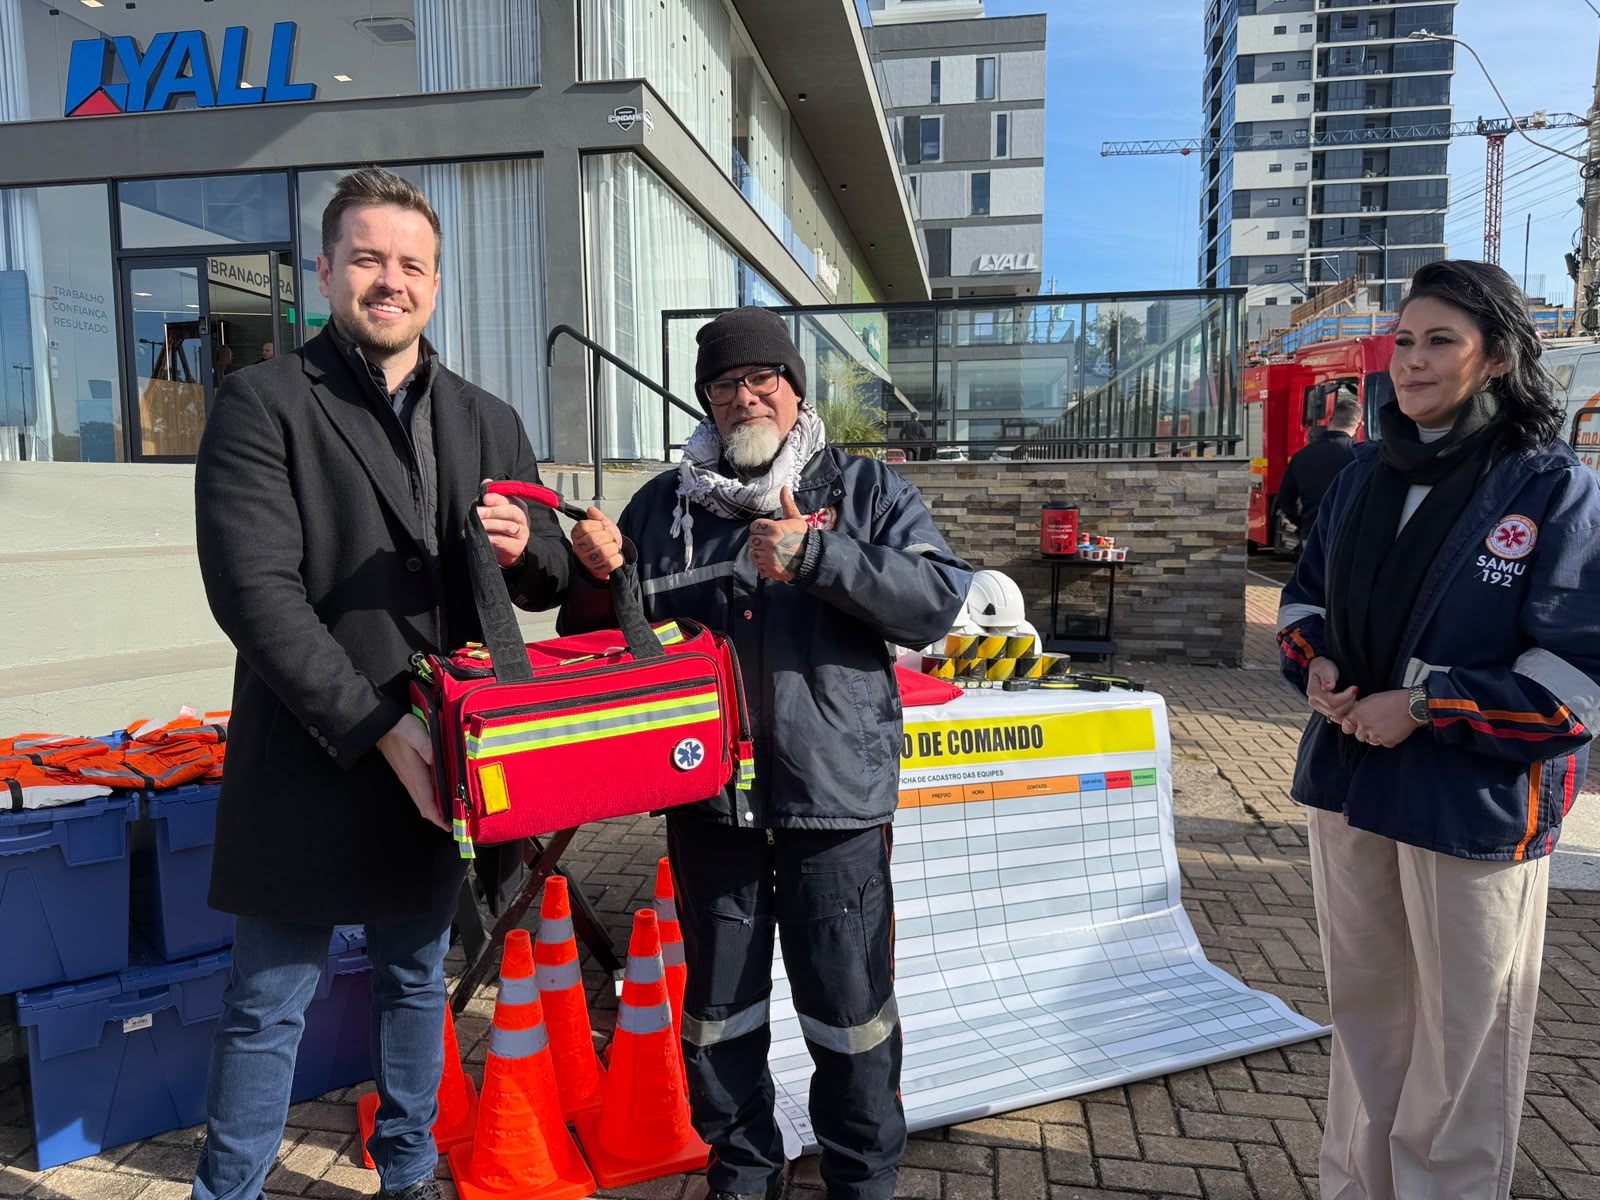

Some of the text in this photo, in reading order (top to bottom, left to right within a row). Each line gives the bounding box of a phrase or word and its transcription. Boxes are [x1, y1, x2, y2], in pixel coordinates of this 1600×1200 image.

[65, 21, 317, 117] LYALL
[978, 252, 1039, 272] LYALL
[52, 285, 105, 304] TRABALHO
[52, 301, 108, 321] CONFIANÇA
[53, 316, 109, 334] RESULTADO
[1576, 427, 1600, 447] Emp
[1476, 554, 1527, 576] SAMU
[1481, 568, 1513, 588] 192
[901, 724, 1044, 759] O DE COMANDO
[917, 775, 927, 783] DE
[927, 772, 962, 782] CADASTRO
[962, 771, 976, 779] DAS
[977, 769, 1004, 777] EQUIPES
[1026, 783, 1048, 791] CONTATO
